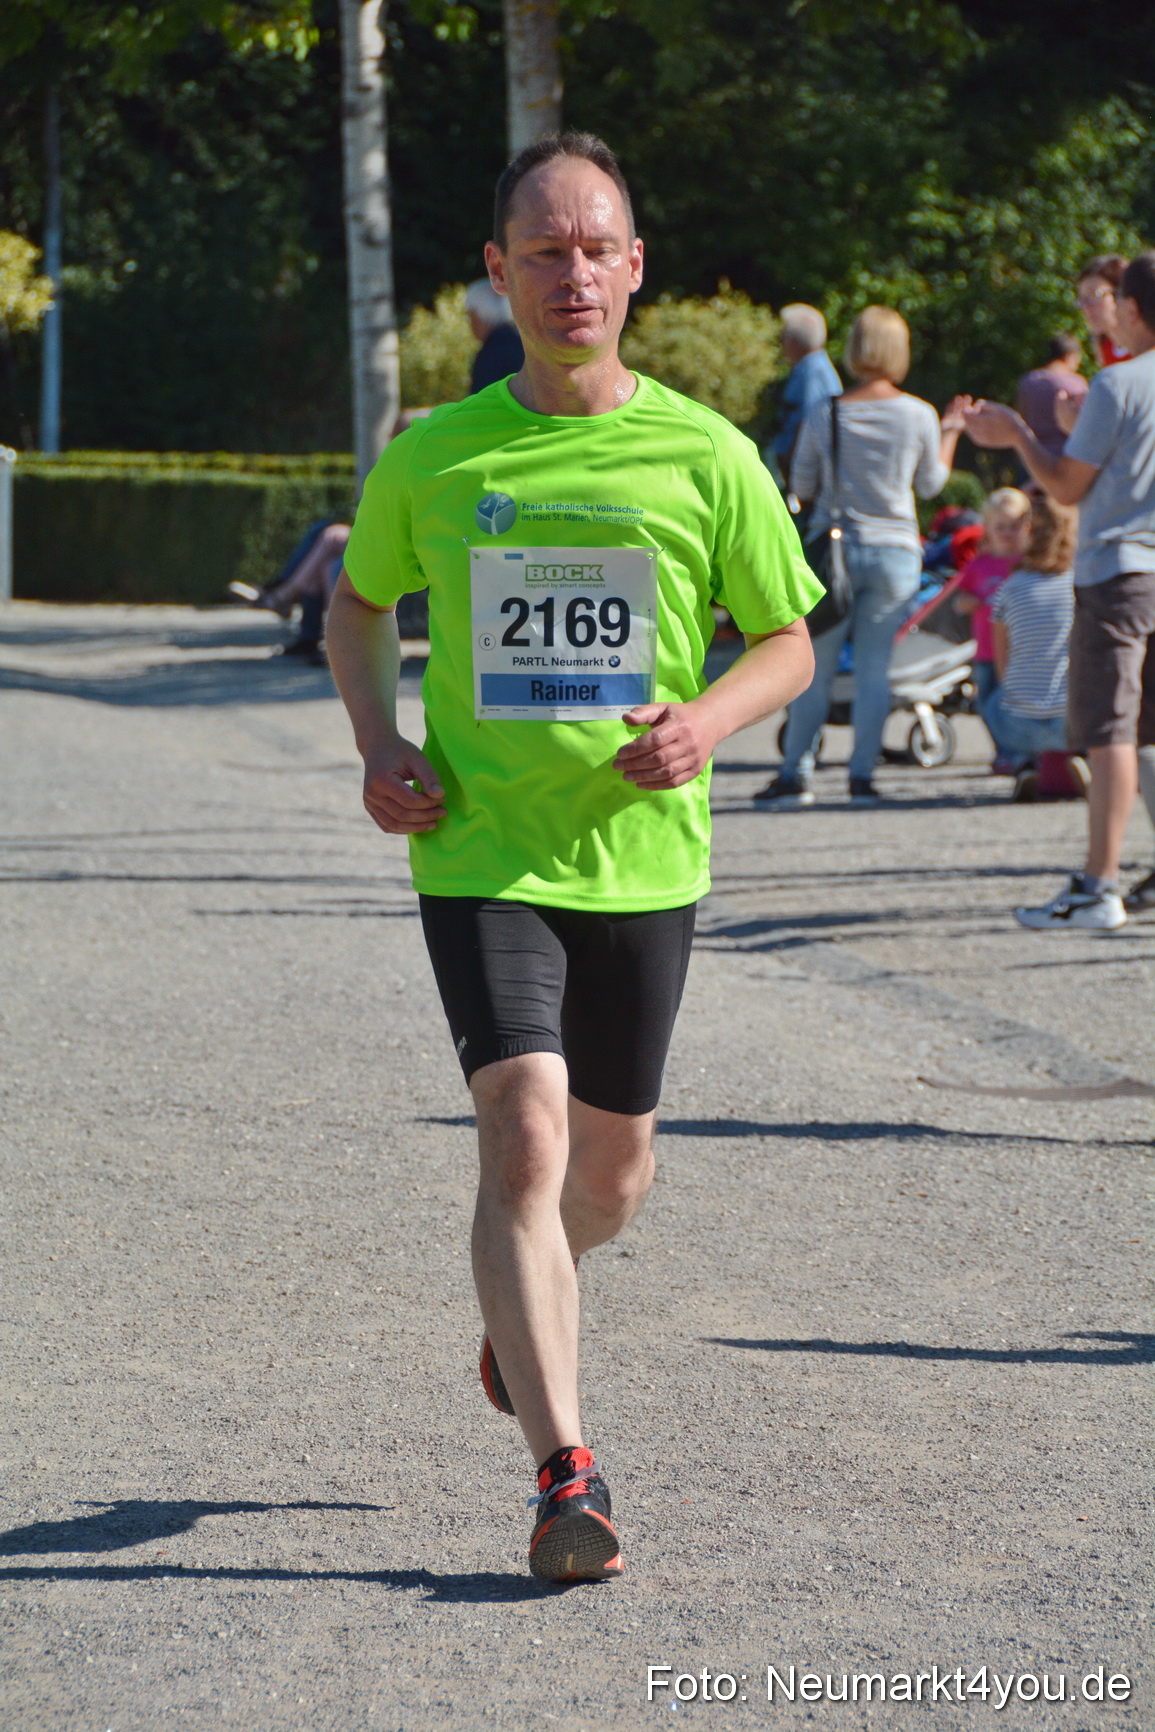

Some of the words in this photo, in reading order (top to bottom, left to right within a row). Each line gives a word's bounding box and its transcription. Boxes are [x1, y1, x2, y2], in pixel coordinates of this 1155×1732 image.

[522, 503, 542, 511] Freie
[545, 503, 594, 512] katholische
[596, 504, 644, 516] Volksschule
[533, 513, 551, 521] Haus
[564, 514, 591, 523] Marien,
[525, 564, 605, 581] BOCK
[500, 596, 631, 648] 2169
[512, 657, 549, 667] PARTL
[551, 656, 604, 667] Neumarkt
[531, 679, 600, 701] Rainer
